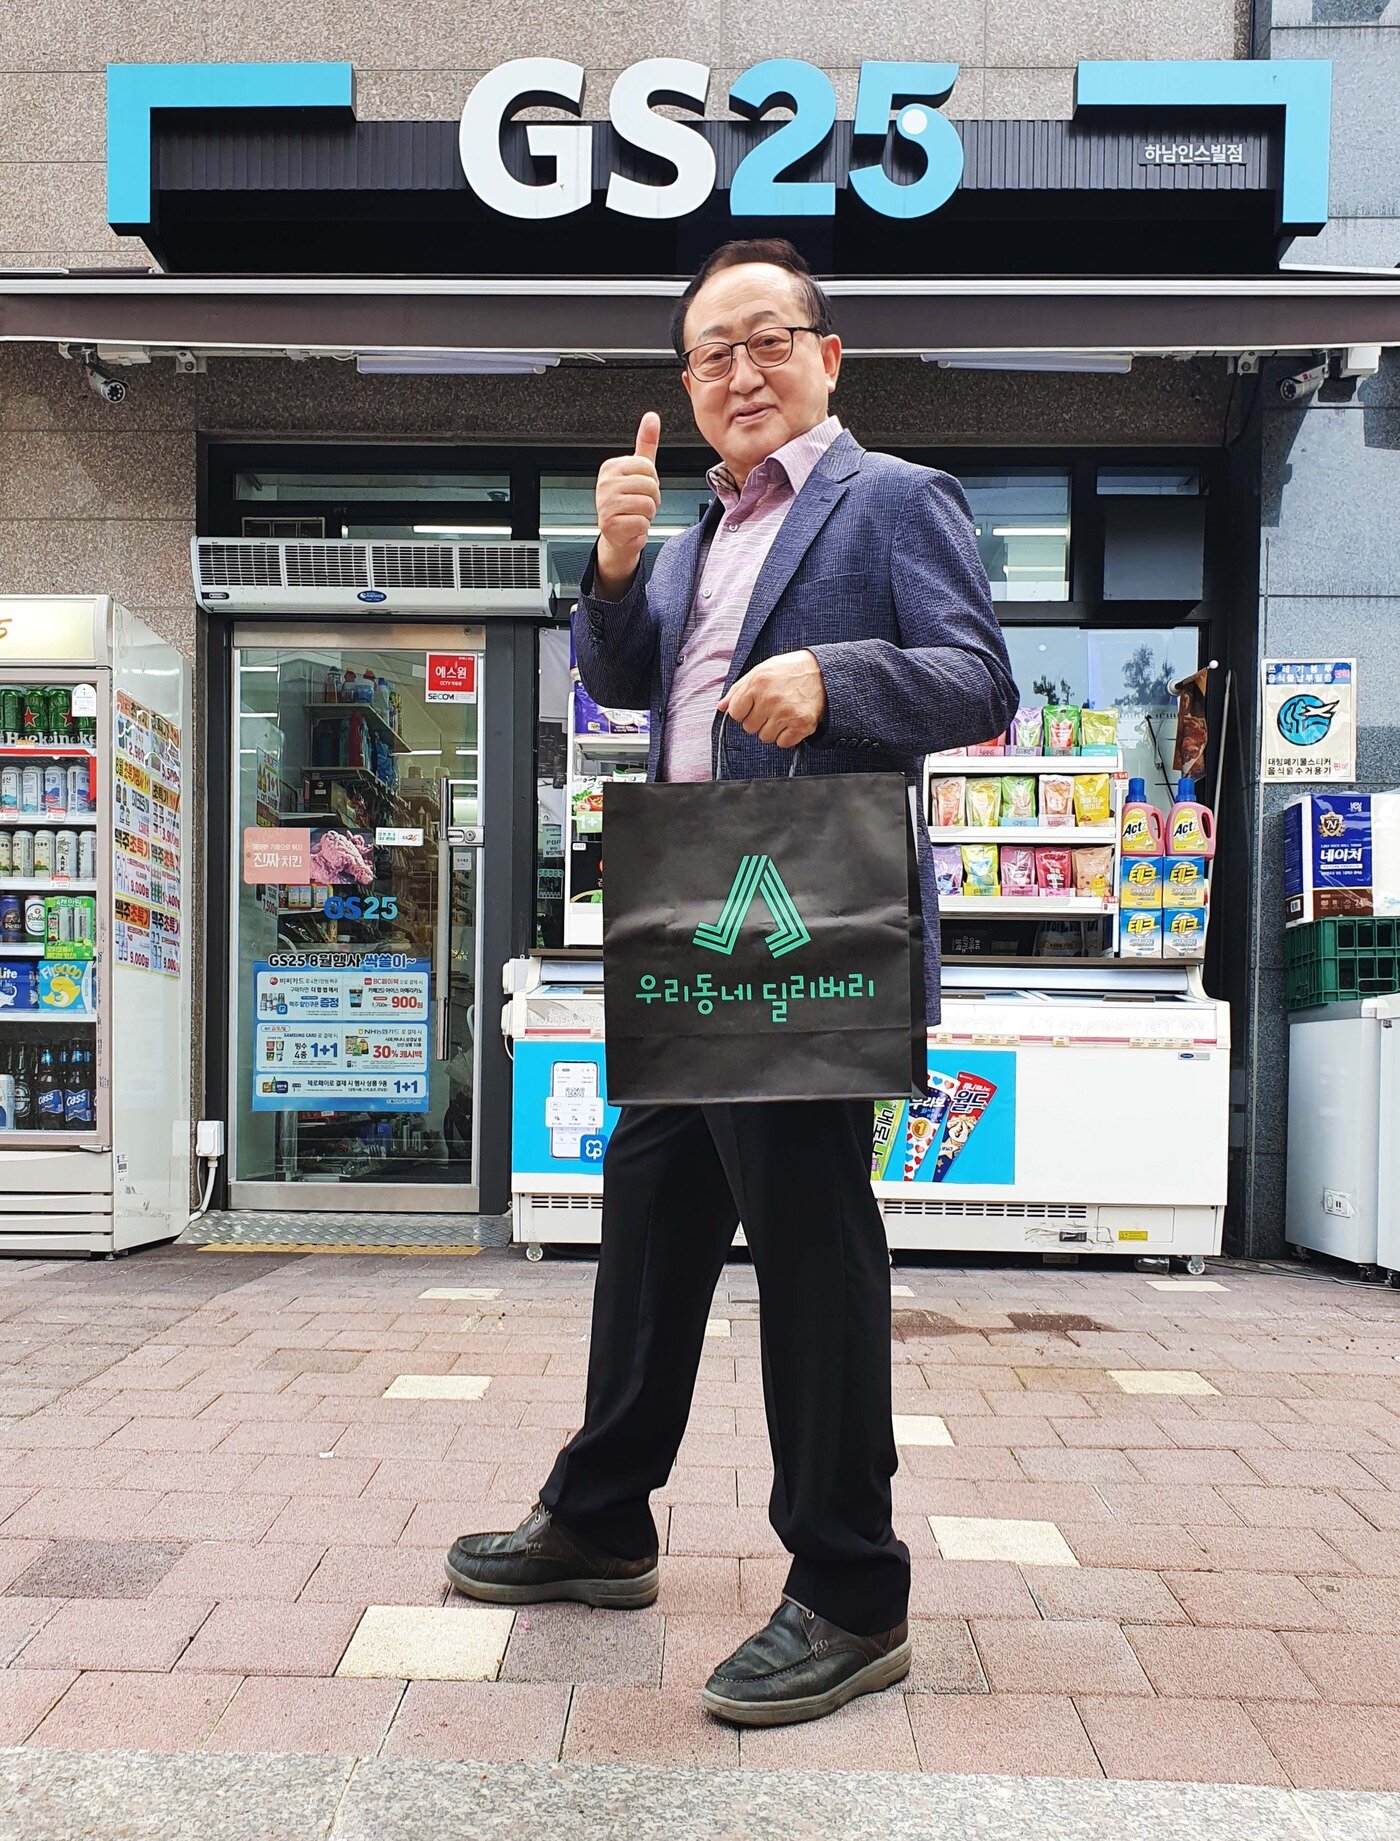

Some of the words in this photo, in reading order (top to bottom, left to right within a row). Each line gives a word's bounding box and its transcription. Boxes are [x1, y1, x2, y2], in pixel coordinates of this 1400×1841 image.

[459, 57, 964, 219] GS25
[1144, 143, 1243, 163] 하남인스빌점
[435, 665, 467, 679] 에스원
[253, 852, 279, 868] 진짜
[281, 855, 303, 868] 치킨
[1321, 848, 1363, 862] 네이처
[1129, 867, 1158, 883] 테크
[1170, 867, 1200, 883] 테크
[323, 896, 398, 920] GS25
[1128, 917, 1157, 933] 테크
[1170, 917, 1200, 933] 테크
[269, 953, 306, 967] GS25
[320, 997, 339, 1008] 증정
[636, 974, 752, 1015] 우리동네
[762, 973, 875, 1023] 딜리버리
[294, 1042, 307, 1051] 빙수
[310, 1042, 338, 1058] 1+1
[373, 1045, 398, 1059] 30%
[294, 1051, 307, 1060] 4종
[393, 1080, 418, 1094] 1+1
[951, 1090, 988, 1113] 월드
[872, 1107, 894, 1156] 메로나
